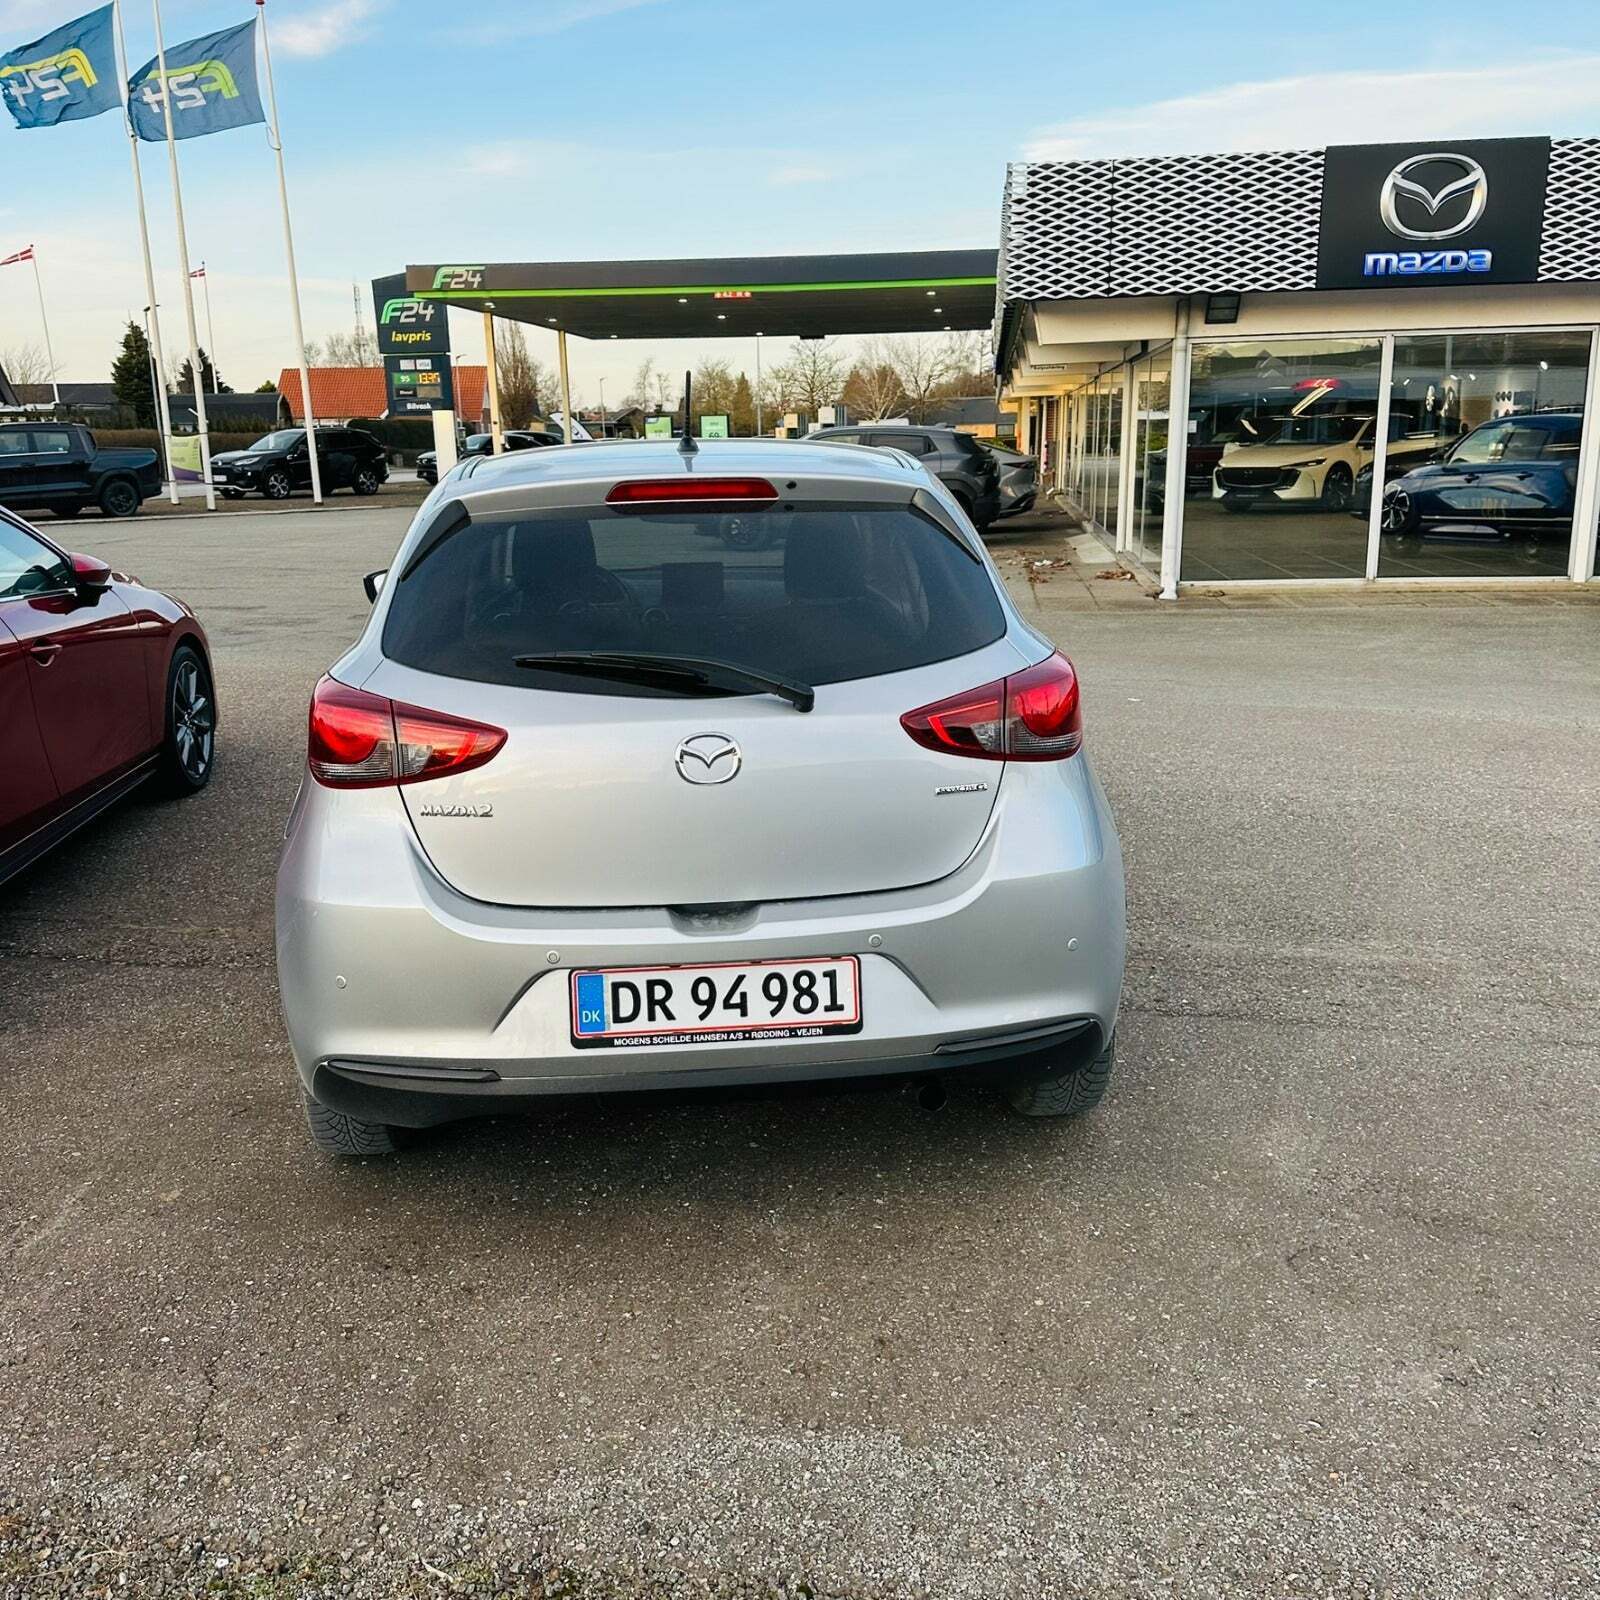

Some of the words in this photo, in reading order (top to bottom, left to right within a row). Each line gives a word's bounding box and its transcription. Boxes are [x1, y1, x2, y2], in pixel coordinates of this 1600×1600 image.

[432, 266, 485, 288] F24
[380, 298, 435, 324] F24
[392, 330, 432, 343] lavpris
[611, 978, 676, 1024] DR
[691, 974, 748, 1021] 94
[762, 969, 845, 1018] 981
[582, 1009, 601, 1023] DK
[614, 1037, 651, 1046] MOGENS
[652, 1034, 692, 1044] SCHELDE
[693, 1032, 728, 1042] HANSEN
[729, 1031, 744, 1040] A/S
[751, 1028, 790, 1039] RØDDING
[796, 1027, 824, 1036] VEJEN
